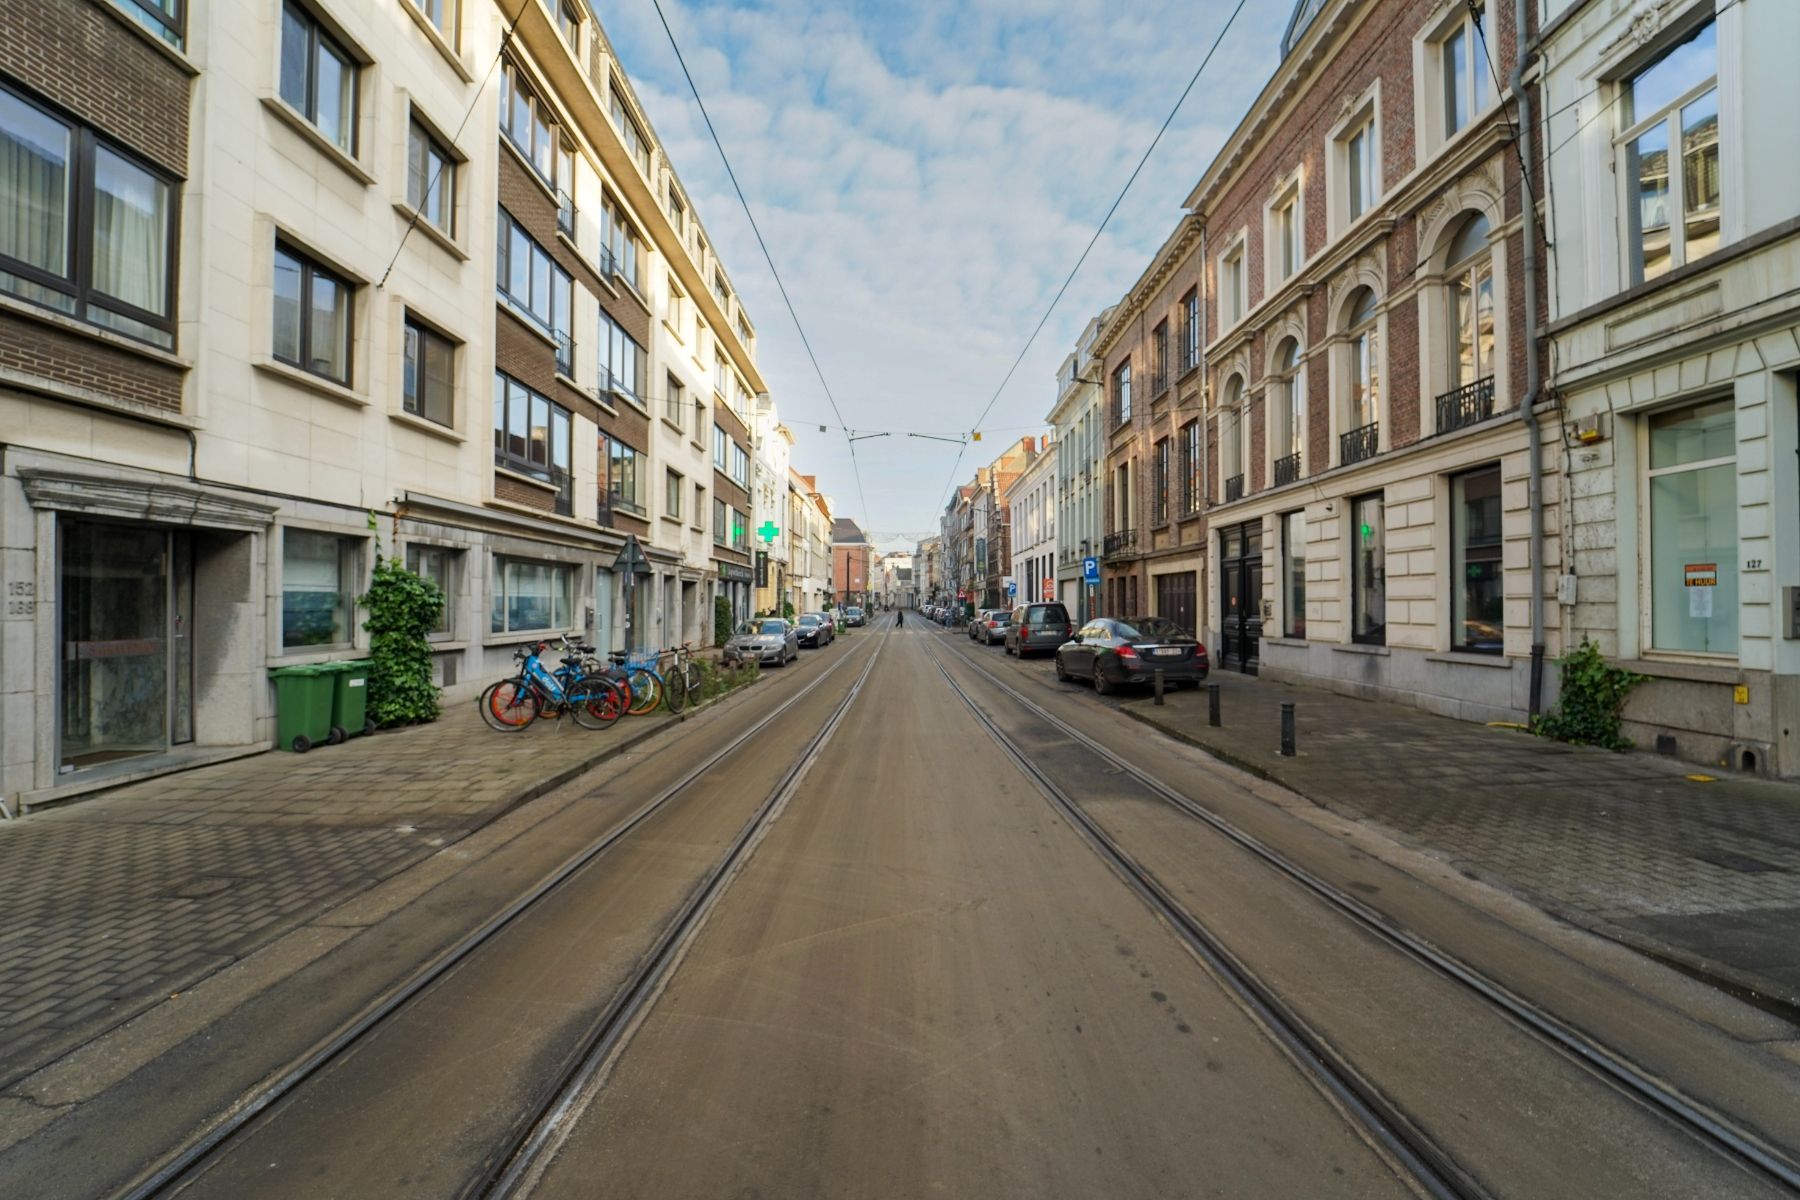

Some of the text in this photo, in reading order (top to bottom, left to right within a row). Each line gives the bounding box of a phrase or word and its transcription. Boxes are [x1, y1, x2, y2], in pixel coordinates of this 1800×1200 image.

[1085, 561, 1095, 575] P
[1747, 560, 1762, 568] 127
[1695, 578, 1716, 586] HUUR
[8, 581, 34, 596] 152
[1010, 584, 1016, 592] P
